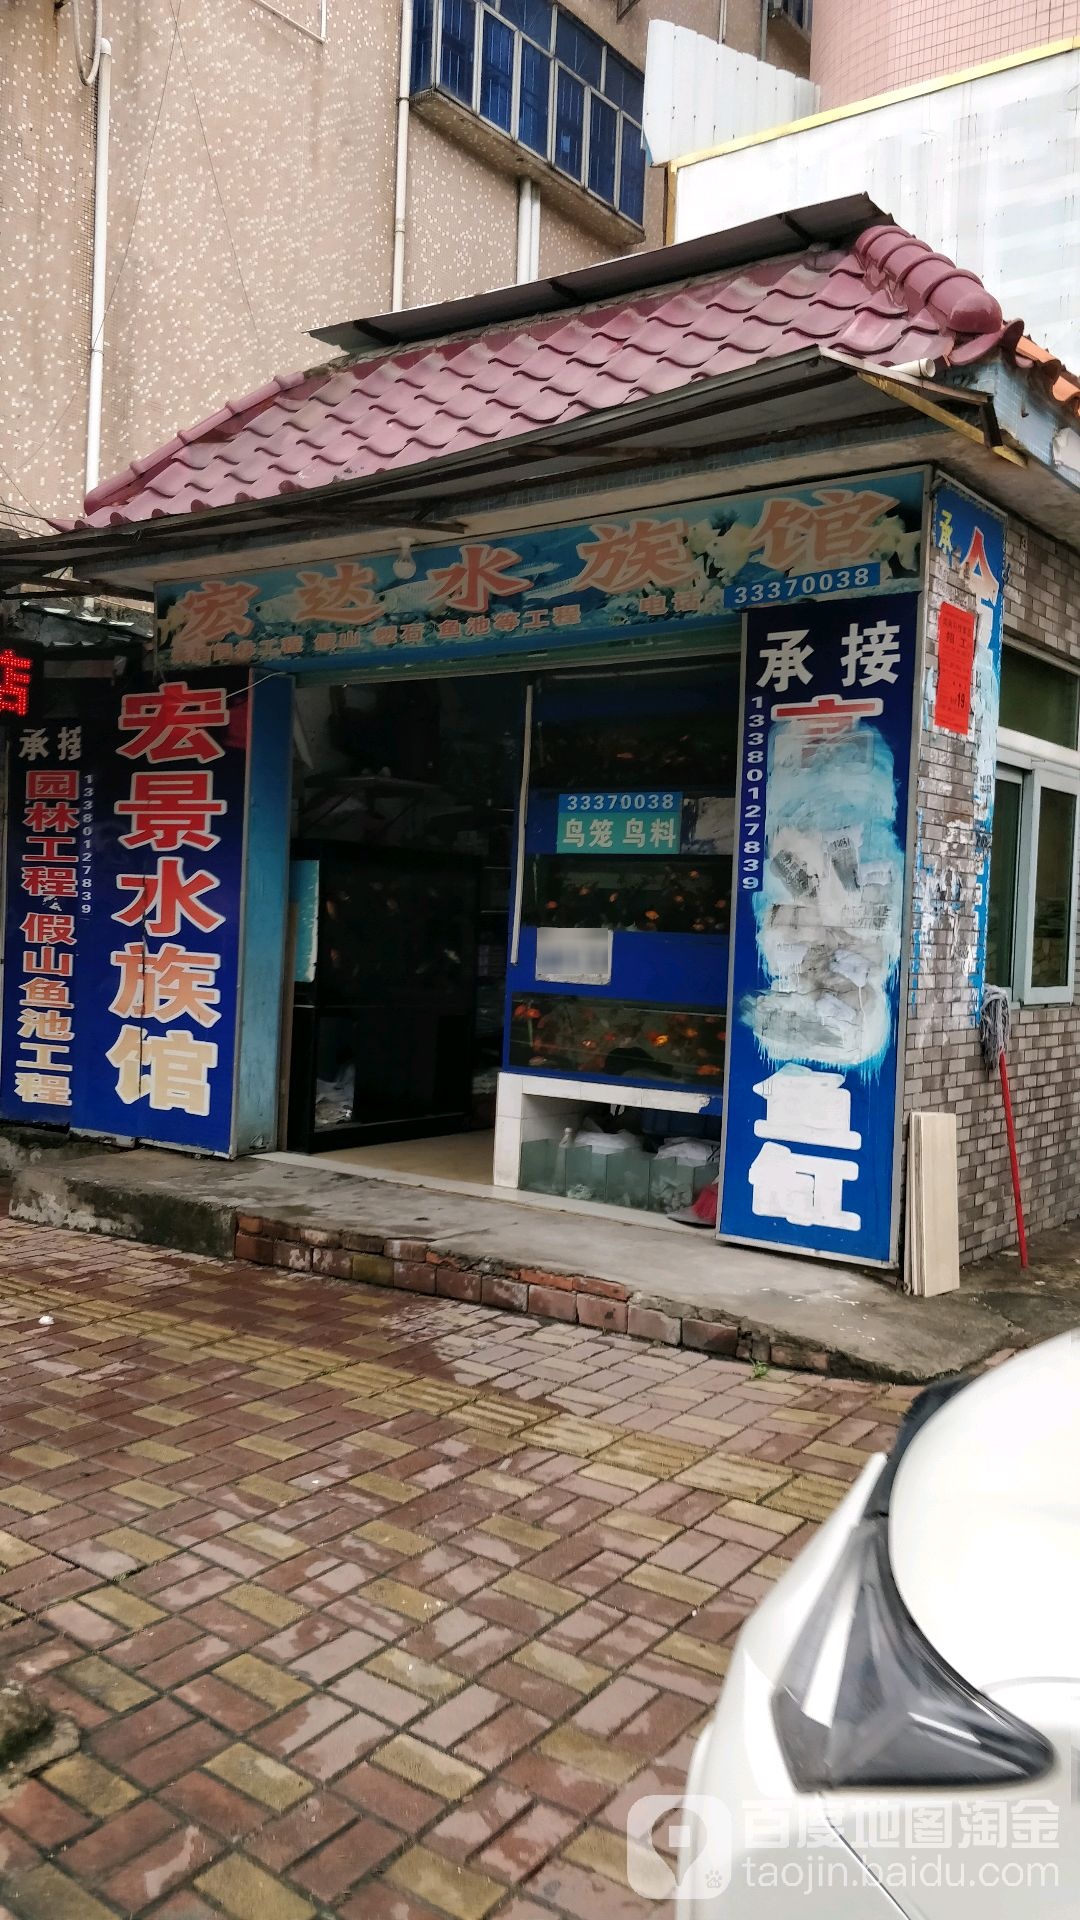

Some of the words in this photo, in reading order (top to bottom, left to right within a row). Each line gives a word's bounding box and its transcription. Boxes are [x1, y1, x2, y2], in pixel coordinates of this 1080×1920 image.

[181, 489, 901, 641] 宏达水族馆
[438, 604, 581, 640] 鱼池等工程
[734, 567, 870, 605] 33370038
[756, 619, 901, 693] 承接
[19, 726, 82, 761] 承接
[567, 794, 674, 811] 33370038
[742, 696, 765, 890] 13380127839
[80, 774, 95, 915] 13380127839
[106, 681, 229, 1116] 宏景水族馆
[15, 912, 77, 1107] 假山鱼池工程
